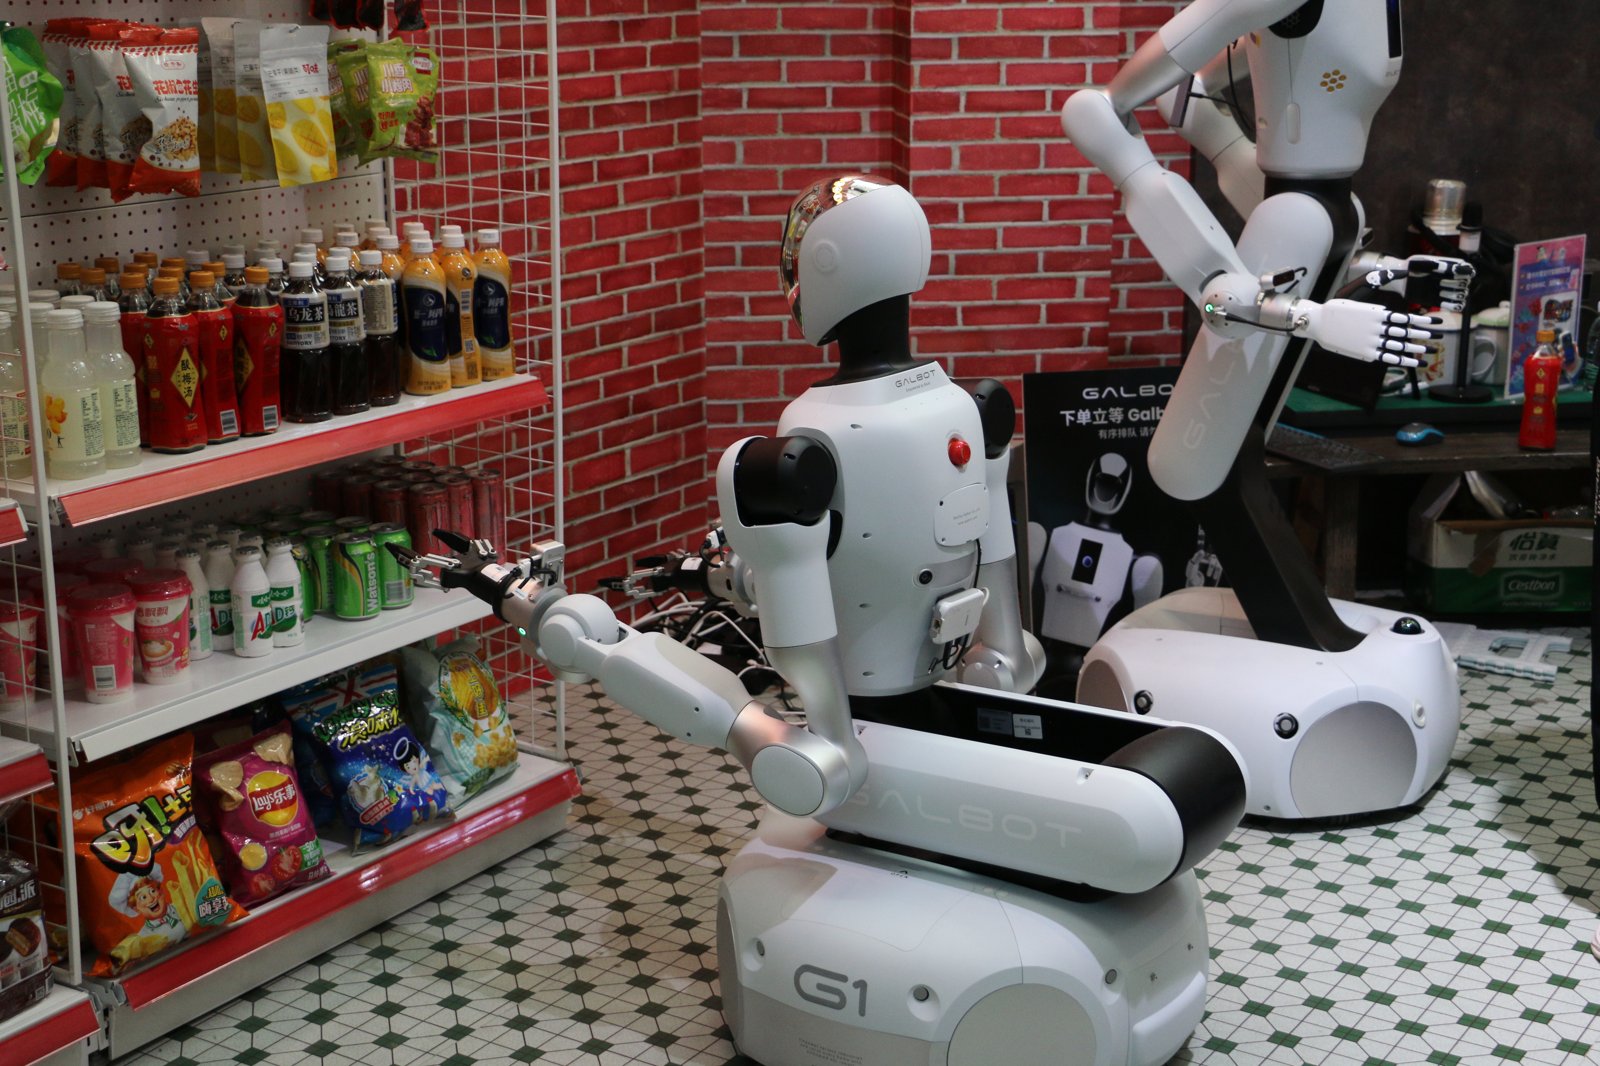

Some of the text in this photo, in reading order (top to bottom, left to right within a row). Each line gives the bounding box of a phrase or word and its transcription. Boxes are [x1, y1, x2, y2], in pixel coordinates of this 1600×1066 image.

[288, 305, 323, 323] 乌龙茶
[181, 359, 193, 398] 酸梅汤
[895, 368, 936, 388] GALBOT
[1060, 407, 1124, 426] 下单立等
[1099, 427, 1137, 439] 有序排队
[367, 552, 378, 612] Watson's
[1508, 580, 1555, 591] Cestbon
[252, 792, 275, 812] Lay's
[273, 783, 296, 805] 乐事
[794, 964, 868, 1018] G1
